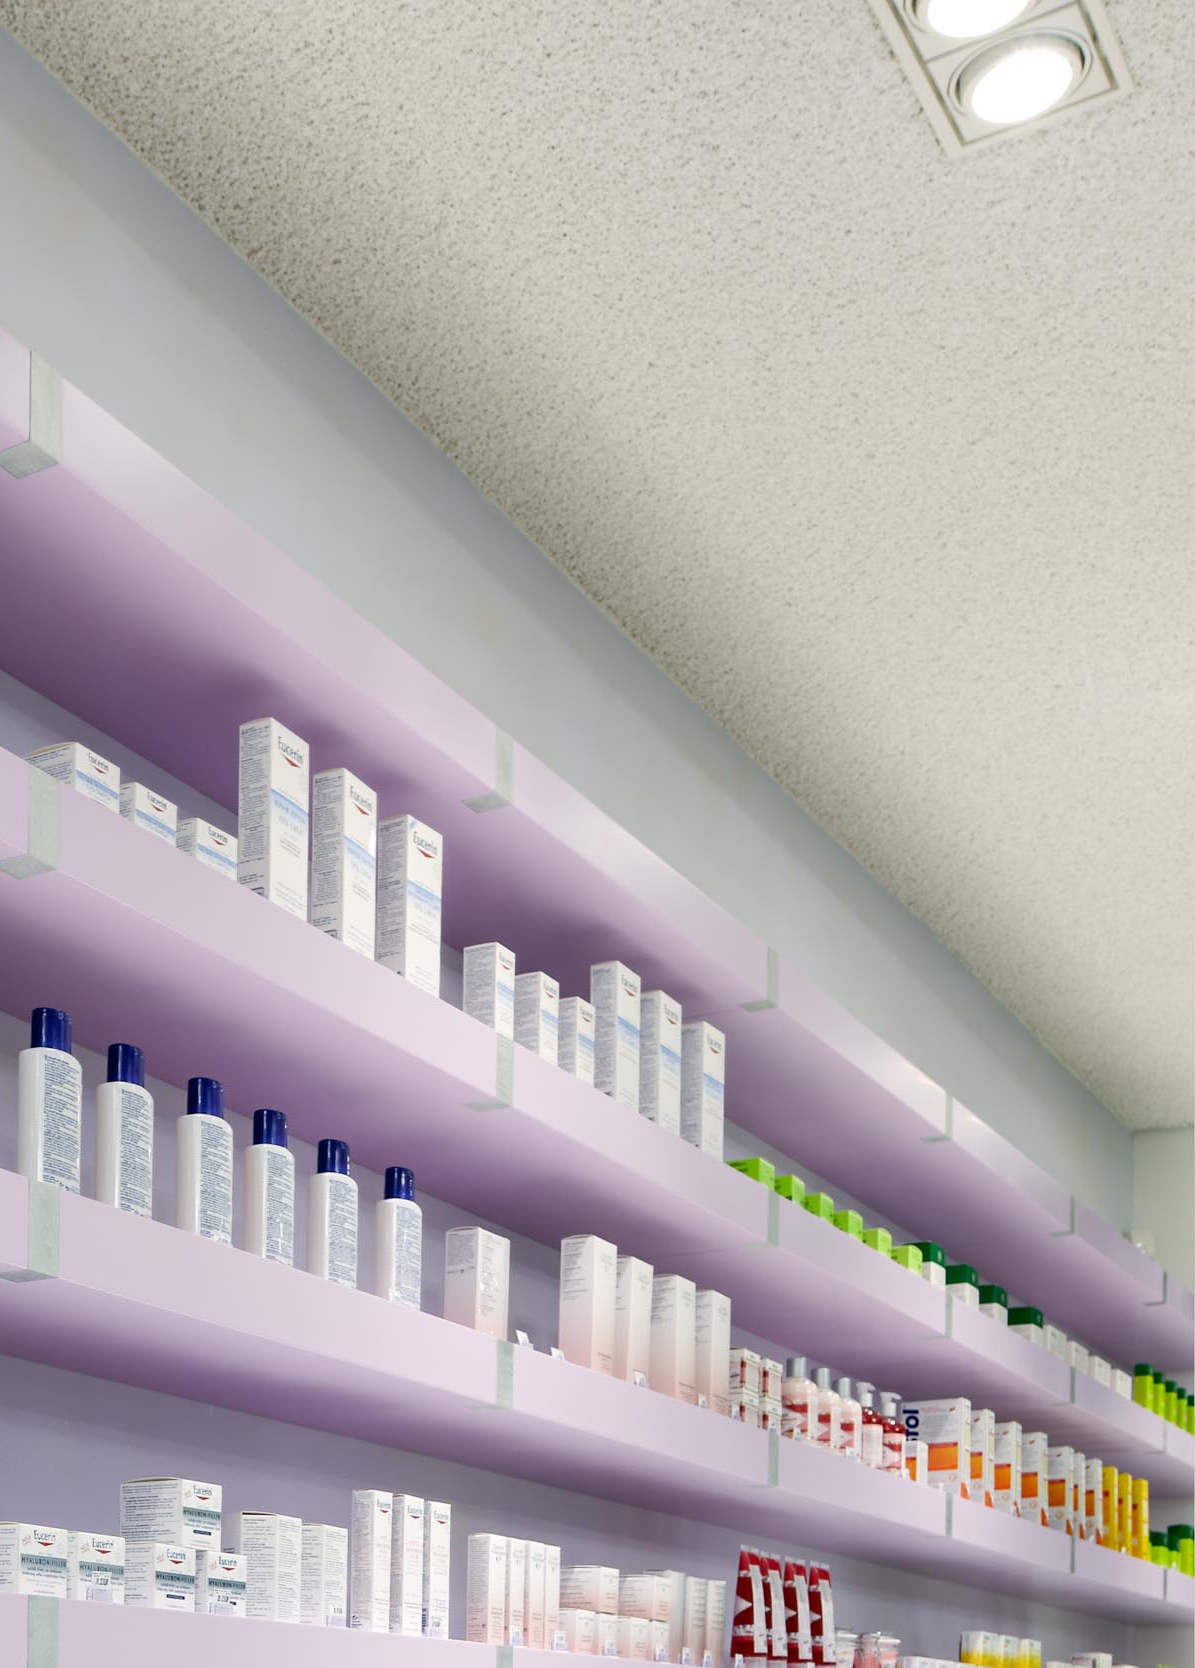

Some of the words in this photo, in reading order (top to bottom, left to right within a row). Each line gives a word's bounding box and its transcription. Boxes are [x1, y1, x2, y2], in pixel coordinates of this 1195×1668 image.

[277, 736, 304, 766] Eucerin
[349, 785, 373, 815] Eucerin
[207, 826, 228, 845] Eucerin
[413, 831, 439, 858] Eucerin
[193, 1485, 213, 1496] Eucerin
[34, 1530, 56, 1542] Eucerin
[92, 1538, 114, 1549] Eucerin
[167, 1549, 186, 1561] Eucerin
[219, 1556, 237, 1567] Eucerin
